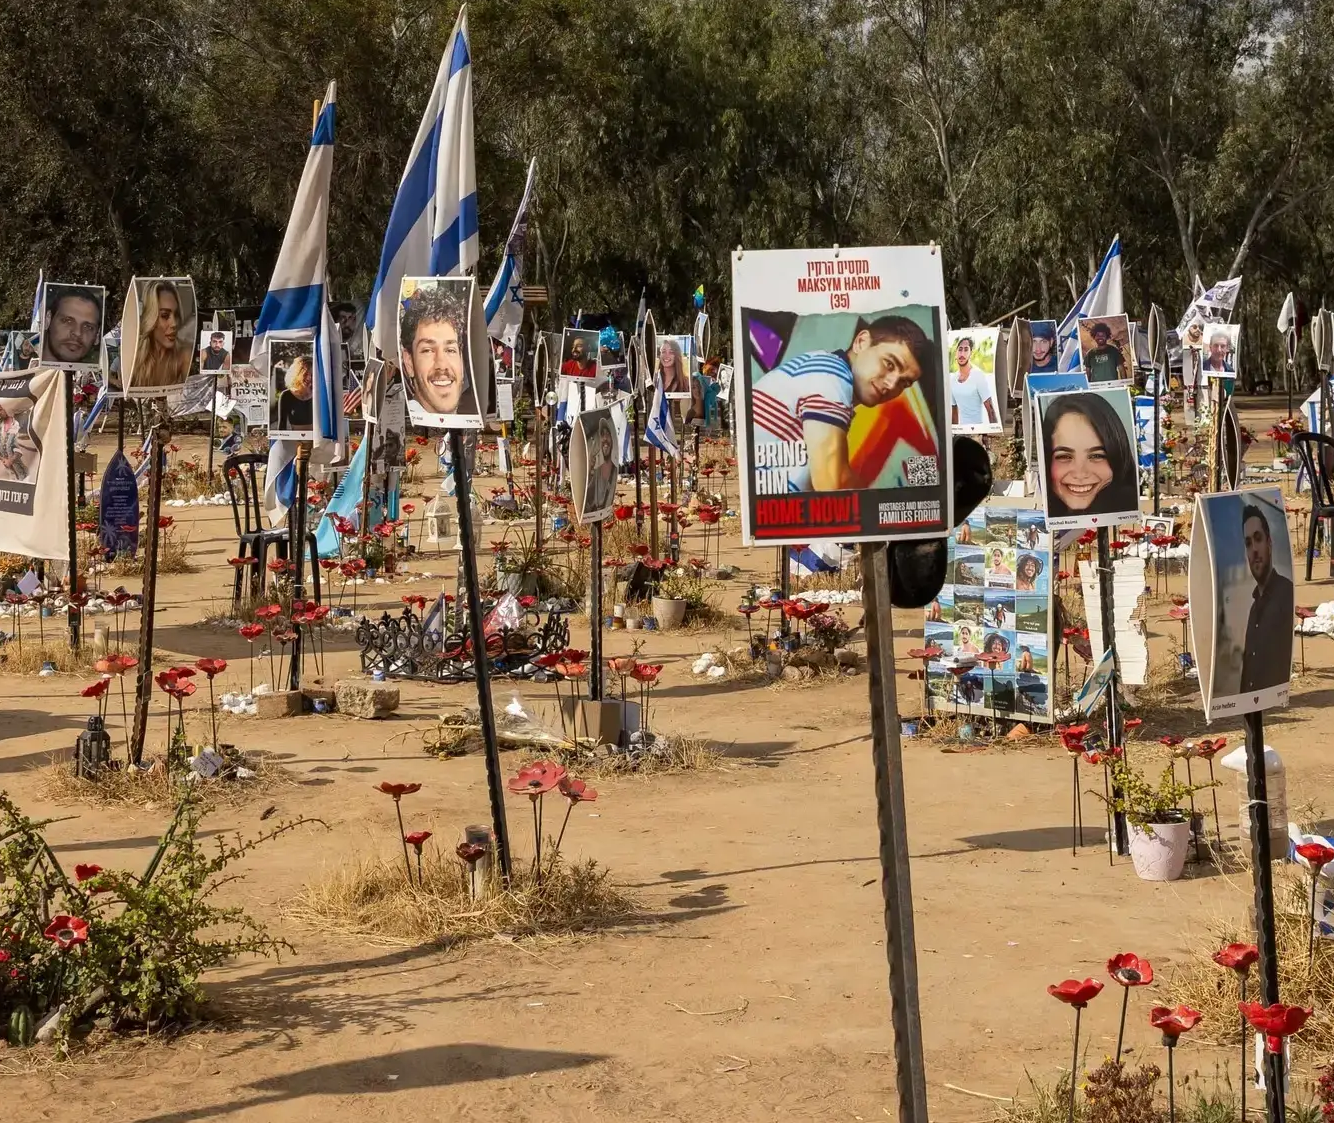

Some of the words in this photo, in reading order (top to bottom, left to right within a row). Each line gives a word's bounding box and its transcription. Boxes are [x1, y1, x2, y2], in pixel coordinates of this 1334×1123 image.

[806, 260, 834, 277] הרקין
[837, 259, 869, 275] מקסים
[798, 277, 842, 292] MAKSYM
[844, 276, 881, 291] HARKIN
[830, 293, 850, 310] (35)
[236, 388, 250, 396] כהן
[252, 387, 267, 395] ליה
[755, 441, 808, 468] BRING
[755, 469, 789, 495] HIM
[11, 491, 22, 504] זכרו
[756, 497, 805, 525] HOME
[810, 492, 860, 523] NOW!
[879, 501, 906, 512] HOSTAGES
[906, 501, 916, 511] AND
[917, 500, 941, 510] MISSING
[879, 511, 913, 524] FAMILIES
[914, 509, 941, 522] FORUM
